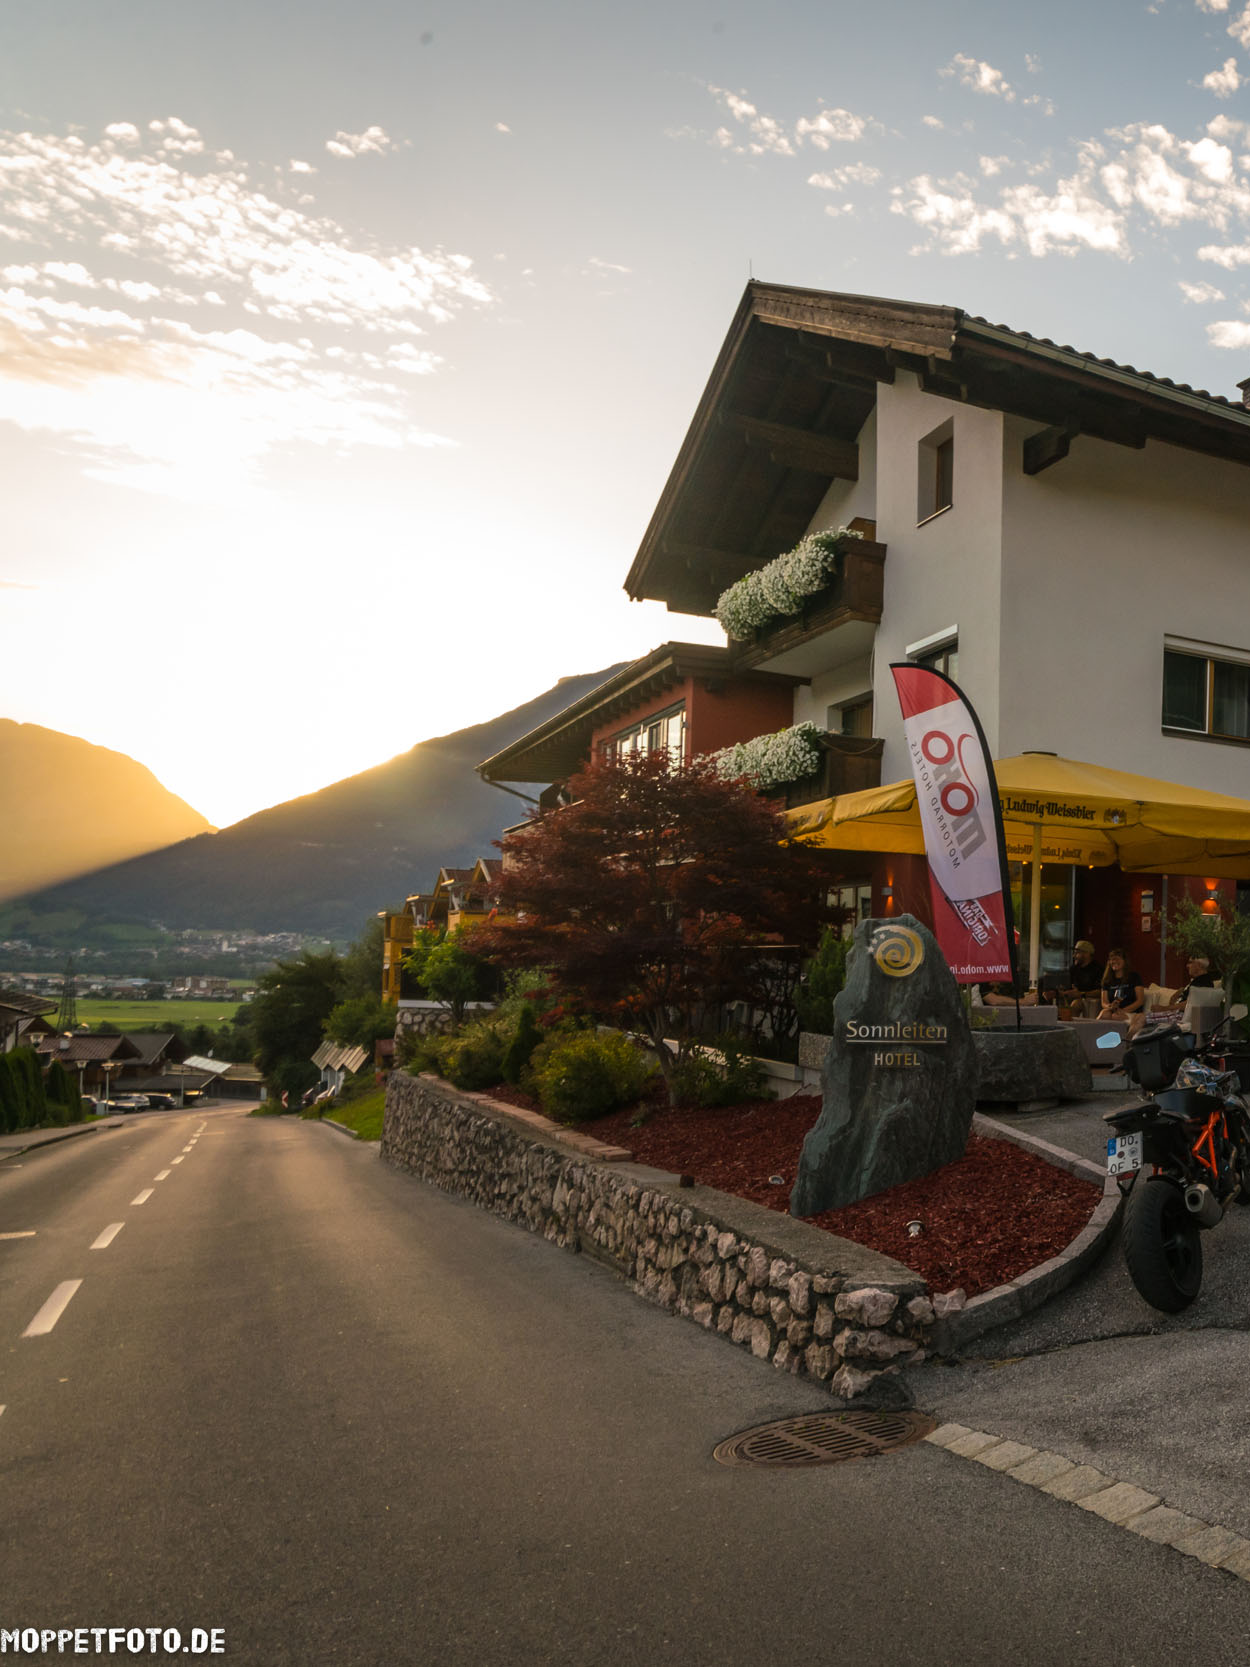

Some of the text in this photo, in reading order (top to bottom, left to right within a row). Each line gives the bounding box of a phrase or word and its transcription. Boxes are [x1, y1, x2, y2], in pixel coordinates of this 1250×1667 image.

[1005, 797, 1046, 818] Ludwig
[1046, 801, 1097, 820] Weissbier
[846, 1020, 947, 1039] Sonnleiten
[874, 1052, 921, 1066] HOTEL
